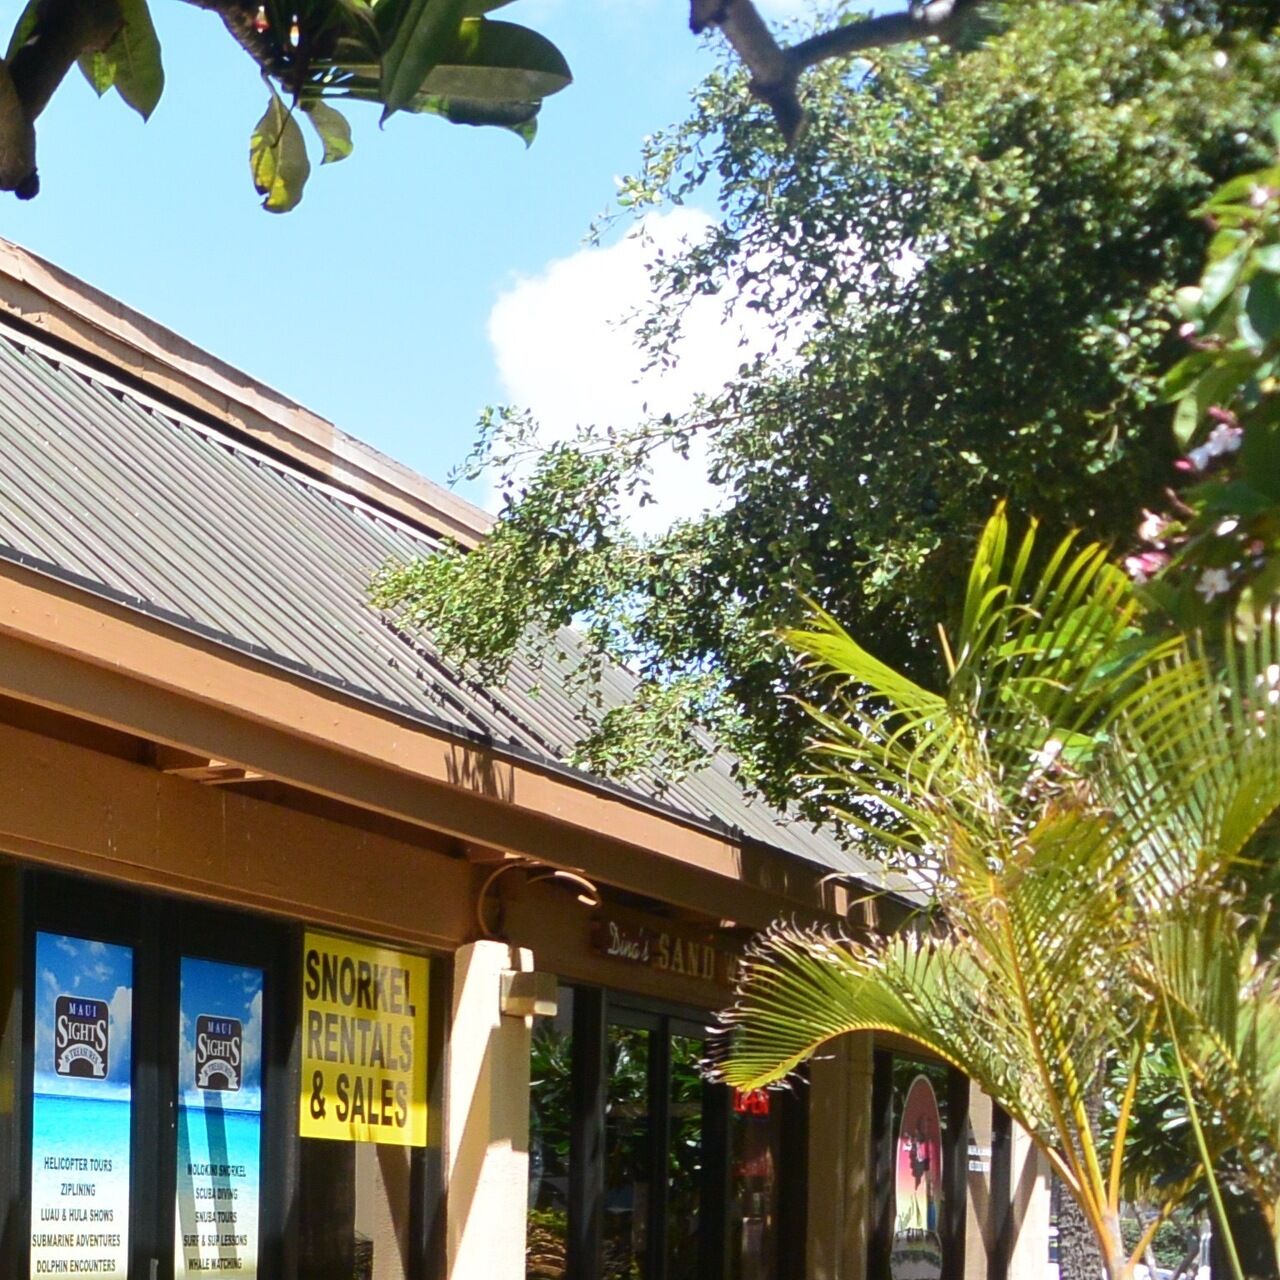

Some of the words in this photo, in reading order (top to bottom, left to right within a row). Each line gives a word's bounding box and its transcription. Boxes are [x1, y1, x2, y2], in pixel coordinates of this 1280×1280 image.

[658, 933, 715, 979] SAND
[305, 949, 416, 1017] SNORKEL
[69, 1002, 97, 1017] MAUI
[56, 1015, 107, 1052] SIGHTS
[207, 1021, 232, 1035] MAUI
[307, 1010, 413, 1073] RENTALS
[197, 1033, 240, 1067] SIGHTS
[310, 1070, 326, 1120] &
[336, 1073, 408, 1128] SALES
[44, 1156, 88, 1171] HELICOPTER
[90, 1158, 113, 1172] TOURS
[61, 1183, 96, 1196] ZIPLINING
[196, 1188, 216, 1200] SCUBA
[217, 1188, 238, 1200] DIVING
[40, 1208, 60, 1221] LUAU
[62, 1208, 67, 1221] &
[69, 1208, 88, 1221] HULA
[89, 1209, 114, 1222] SHOWS
[217, 1211, 238, 1223] TOURS
[32, 1234, 74, 1247] SUBMARINE
[76, 1234, 121, 1247] ADVENTURES
[183, 1235, 199, 1247] SURF
[221, 1234, 248, 1247] LESSONS
[36, 1260, 68, 1273] DOLPHIN
[70, 1259, 116, 1272] ENCOUNTERS
[188, 1258, 210, 1270] WHALE
[211, 1257, 242, 1270] WATCHING
